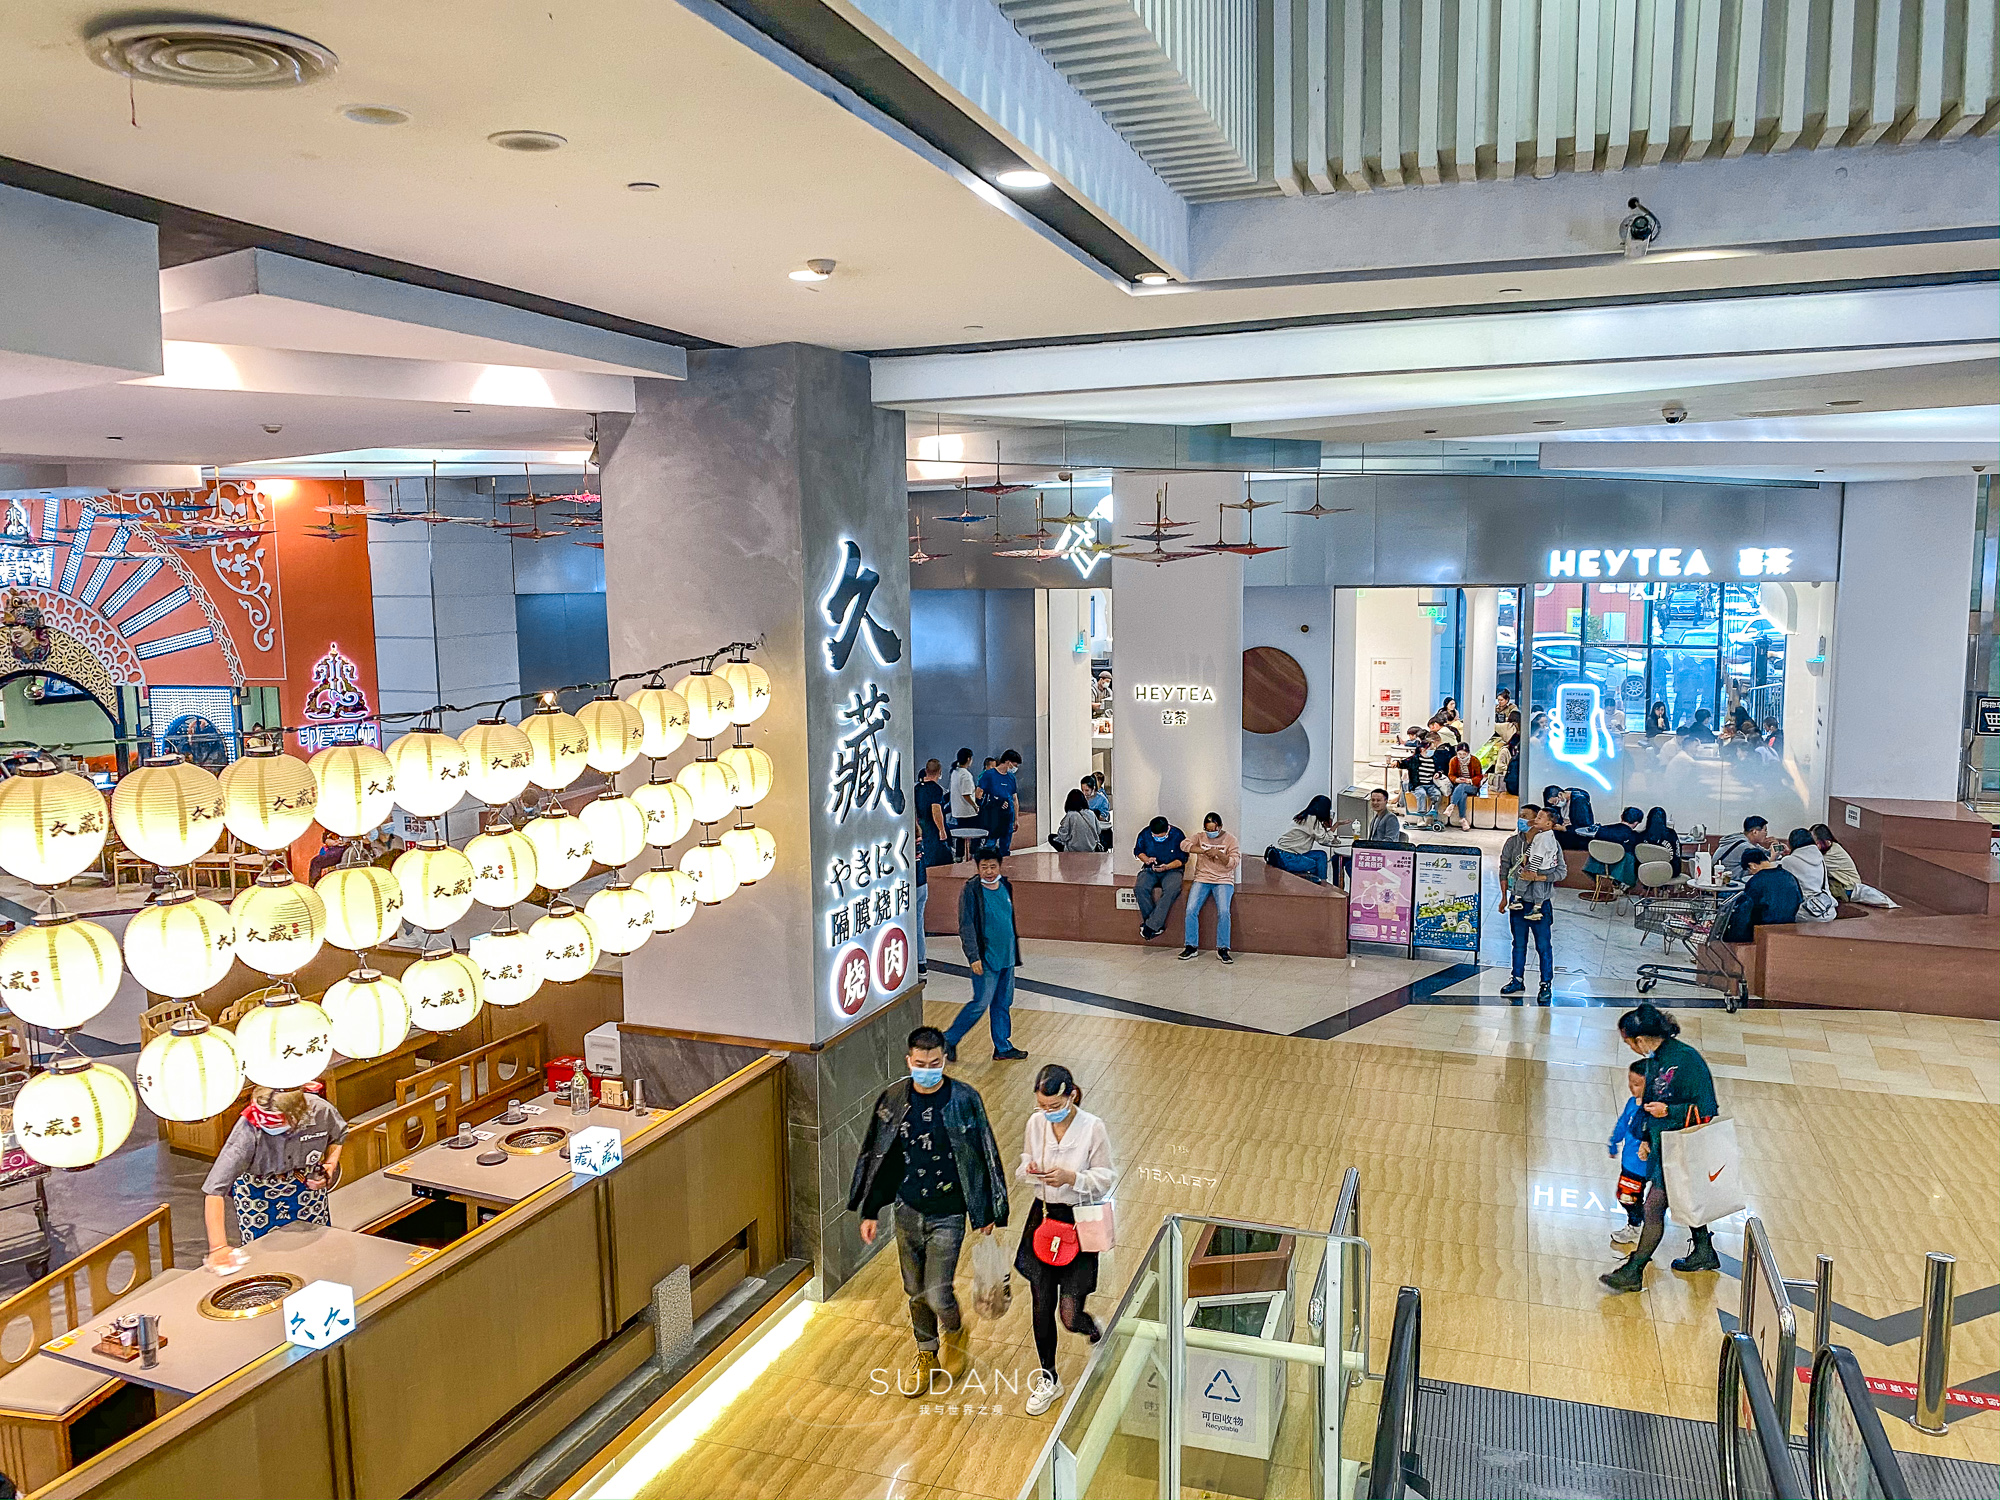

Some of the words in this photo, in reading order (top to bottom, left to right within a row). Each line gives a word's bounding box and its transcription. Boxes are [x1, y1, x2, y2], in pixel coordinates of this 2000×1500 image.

[1549, 548, 1711, 578] HEYTEA
[824, 538, 905, 823] 久藏
[1135, 686, 1214, 701] HEYTEA
[1162, 710, 1187, 725] 喜茶
[1566, 727, 1587, 738] 扫码
[491, 752, 529, 770] 久藏
[273, 788, 314, 812] 久藏
[49, 811, 100, 838] 久藏
[828, 829, 909, 898] やきにく
[433, 878, 468, 899] 久藏
[830, 880, 910, 947] 隔膜烧肉
[247, 924, 294, 942] 久藏
[546, 944, 580, 960] 久藏
[482, 965, 518, 980] 久藏
[843, 937, 905, 1009] 烧肉
[421, 990, 460, 1008] 久藏
[23, 1118, 73, 1137] 久藏
[290, 1311, 315, 1340] 久
[1201, 1411, 1244, 1427] 可回收物
[1205, 1422, 1239, 1433] Recyclable
